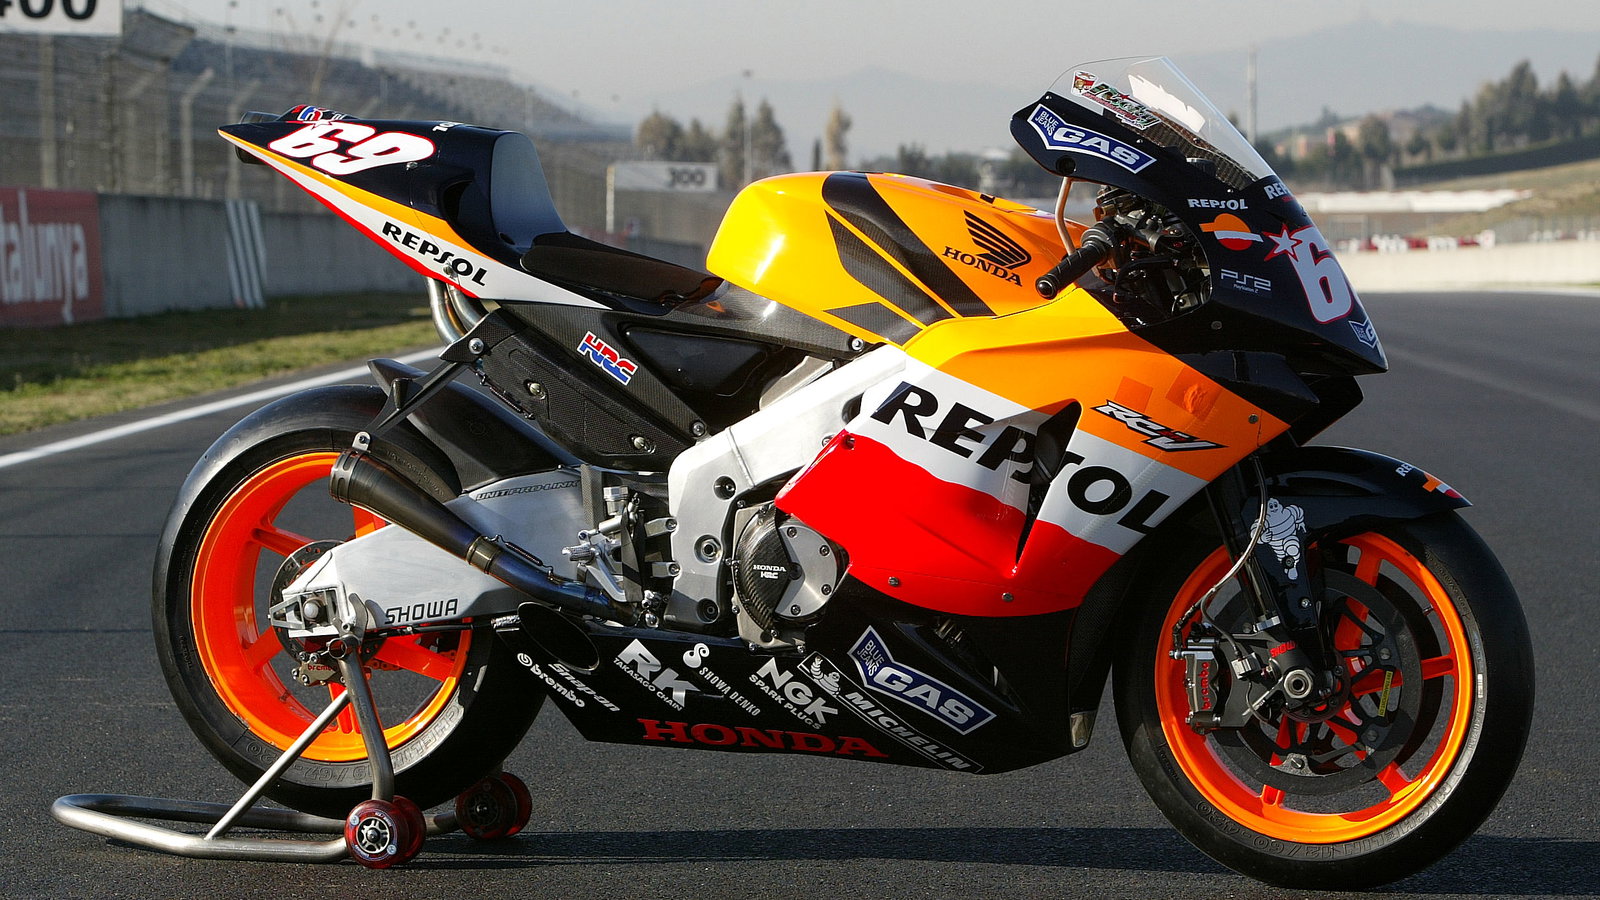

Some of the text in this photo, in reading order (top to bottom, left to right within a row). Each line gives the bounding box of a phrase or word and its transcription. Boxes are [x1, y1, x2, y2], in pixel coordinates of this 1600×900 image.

[1034, 116, 1055, 136] JEANS
[1041, 110, 1059, 128] BLUE
[268, 121, 436, 175] 69
[1052, 127, 1140, 165] GAS
[1187, 198, 1249, 211] REPSOL
[382, 221, 488, 287] REPSOL
[942, 246, 1023, 287] HONDA
[1220, 268, 1271, 291] PS2
[577, 331, 639, 386] HRC
[869, 381, 1171, 535] REPOL
[475, 488, 509, 501] UNIT
[753, 564, 787, 572] HONDA
[385, 598, 458, 625] SHOWA
[617, 638, 701, 708] RK
[857, 649, 878, 677] JEANS
[865, 639, 885, 669] BLUE
[530, 664, 586, 708] brembo
[548, 663, 621, 712] Snap-on
[613, 657, 683, 712] TAKASAGO CHAIN
[699, 666, 761, 717] SHOWA DENKO
[749, 674, 822, 730] SPARK PLUGS
[756, 657, 839, 724] NGK
[873, 666, 975, 725] GAS
[636, 717, 889, 760] HONDA
[845, 691, 972, 771] MICHELIN
